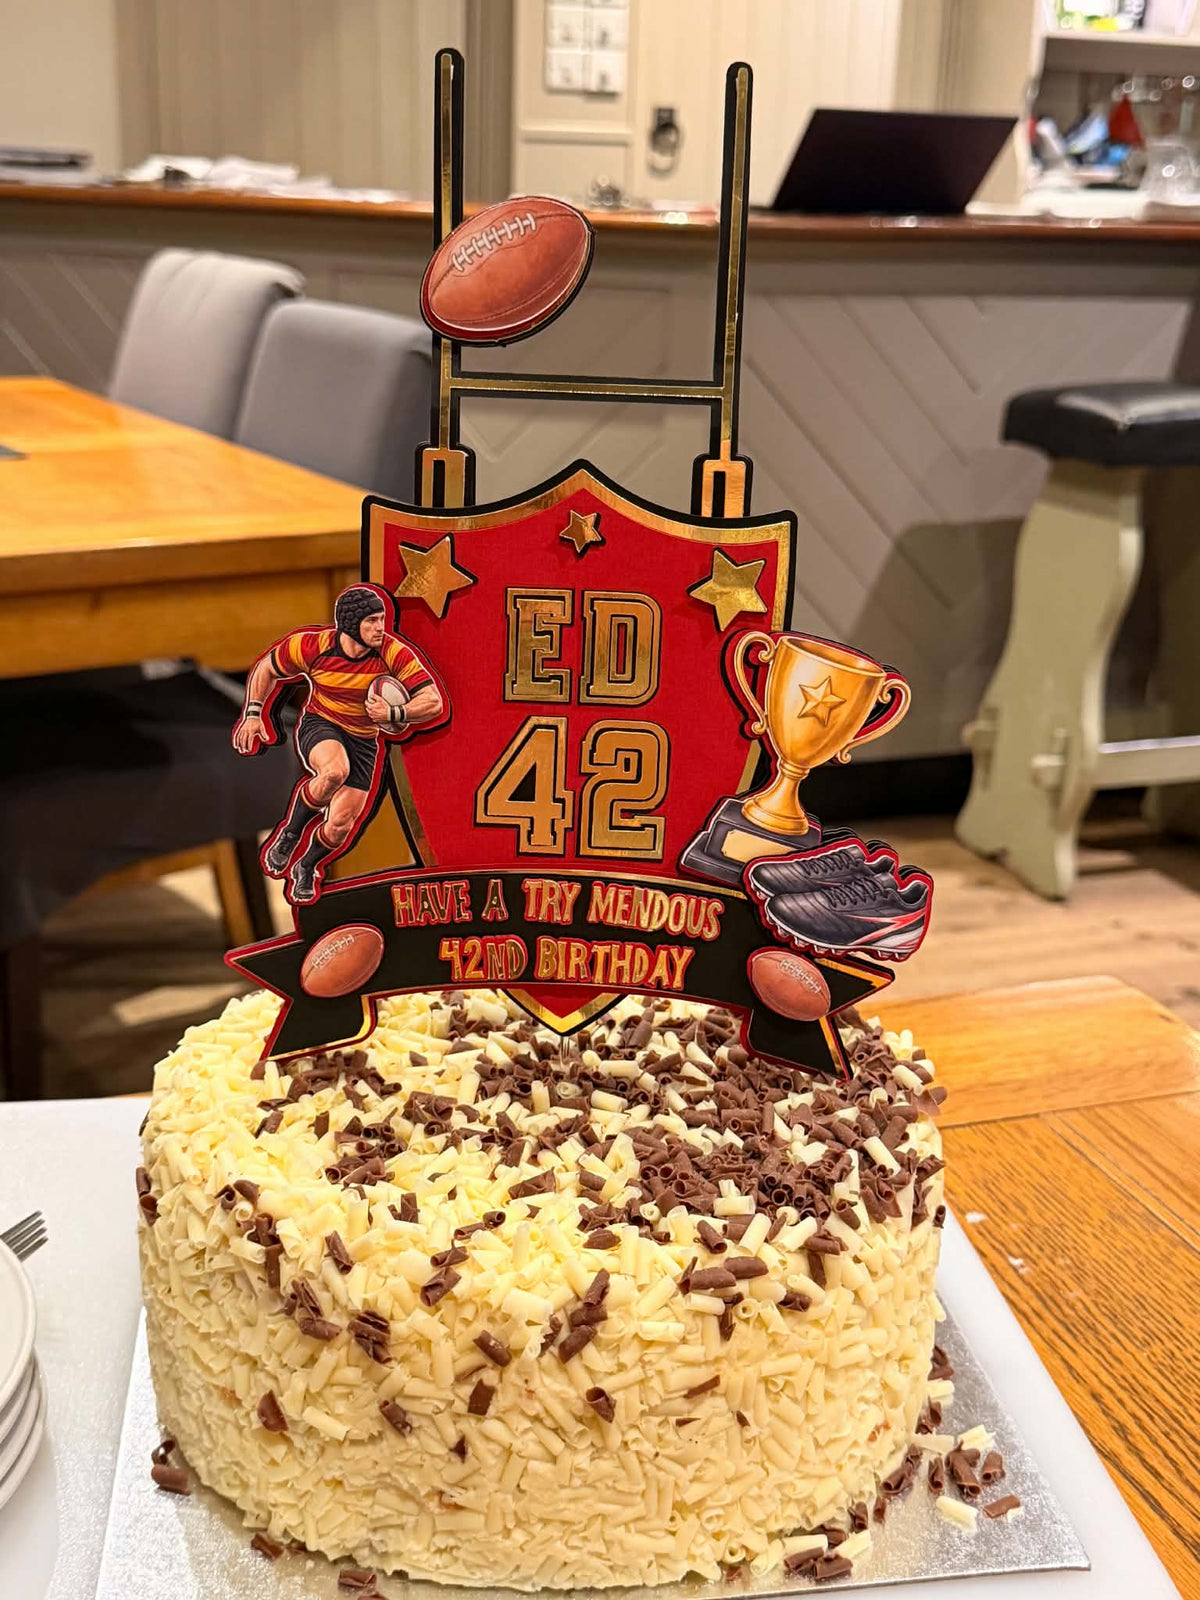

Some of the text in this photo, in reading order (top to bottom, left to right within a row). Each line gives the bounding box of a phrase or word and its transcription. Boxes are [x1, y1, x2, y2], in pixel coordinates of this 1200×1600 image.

[503, 587, 662, 706] ED
[473, 715, 670, 862] 42
[391, 878, 725, 940] HAVE A TRY MENDOUS
[439, 935, 695, 990] 42ND BIRTHDAY
